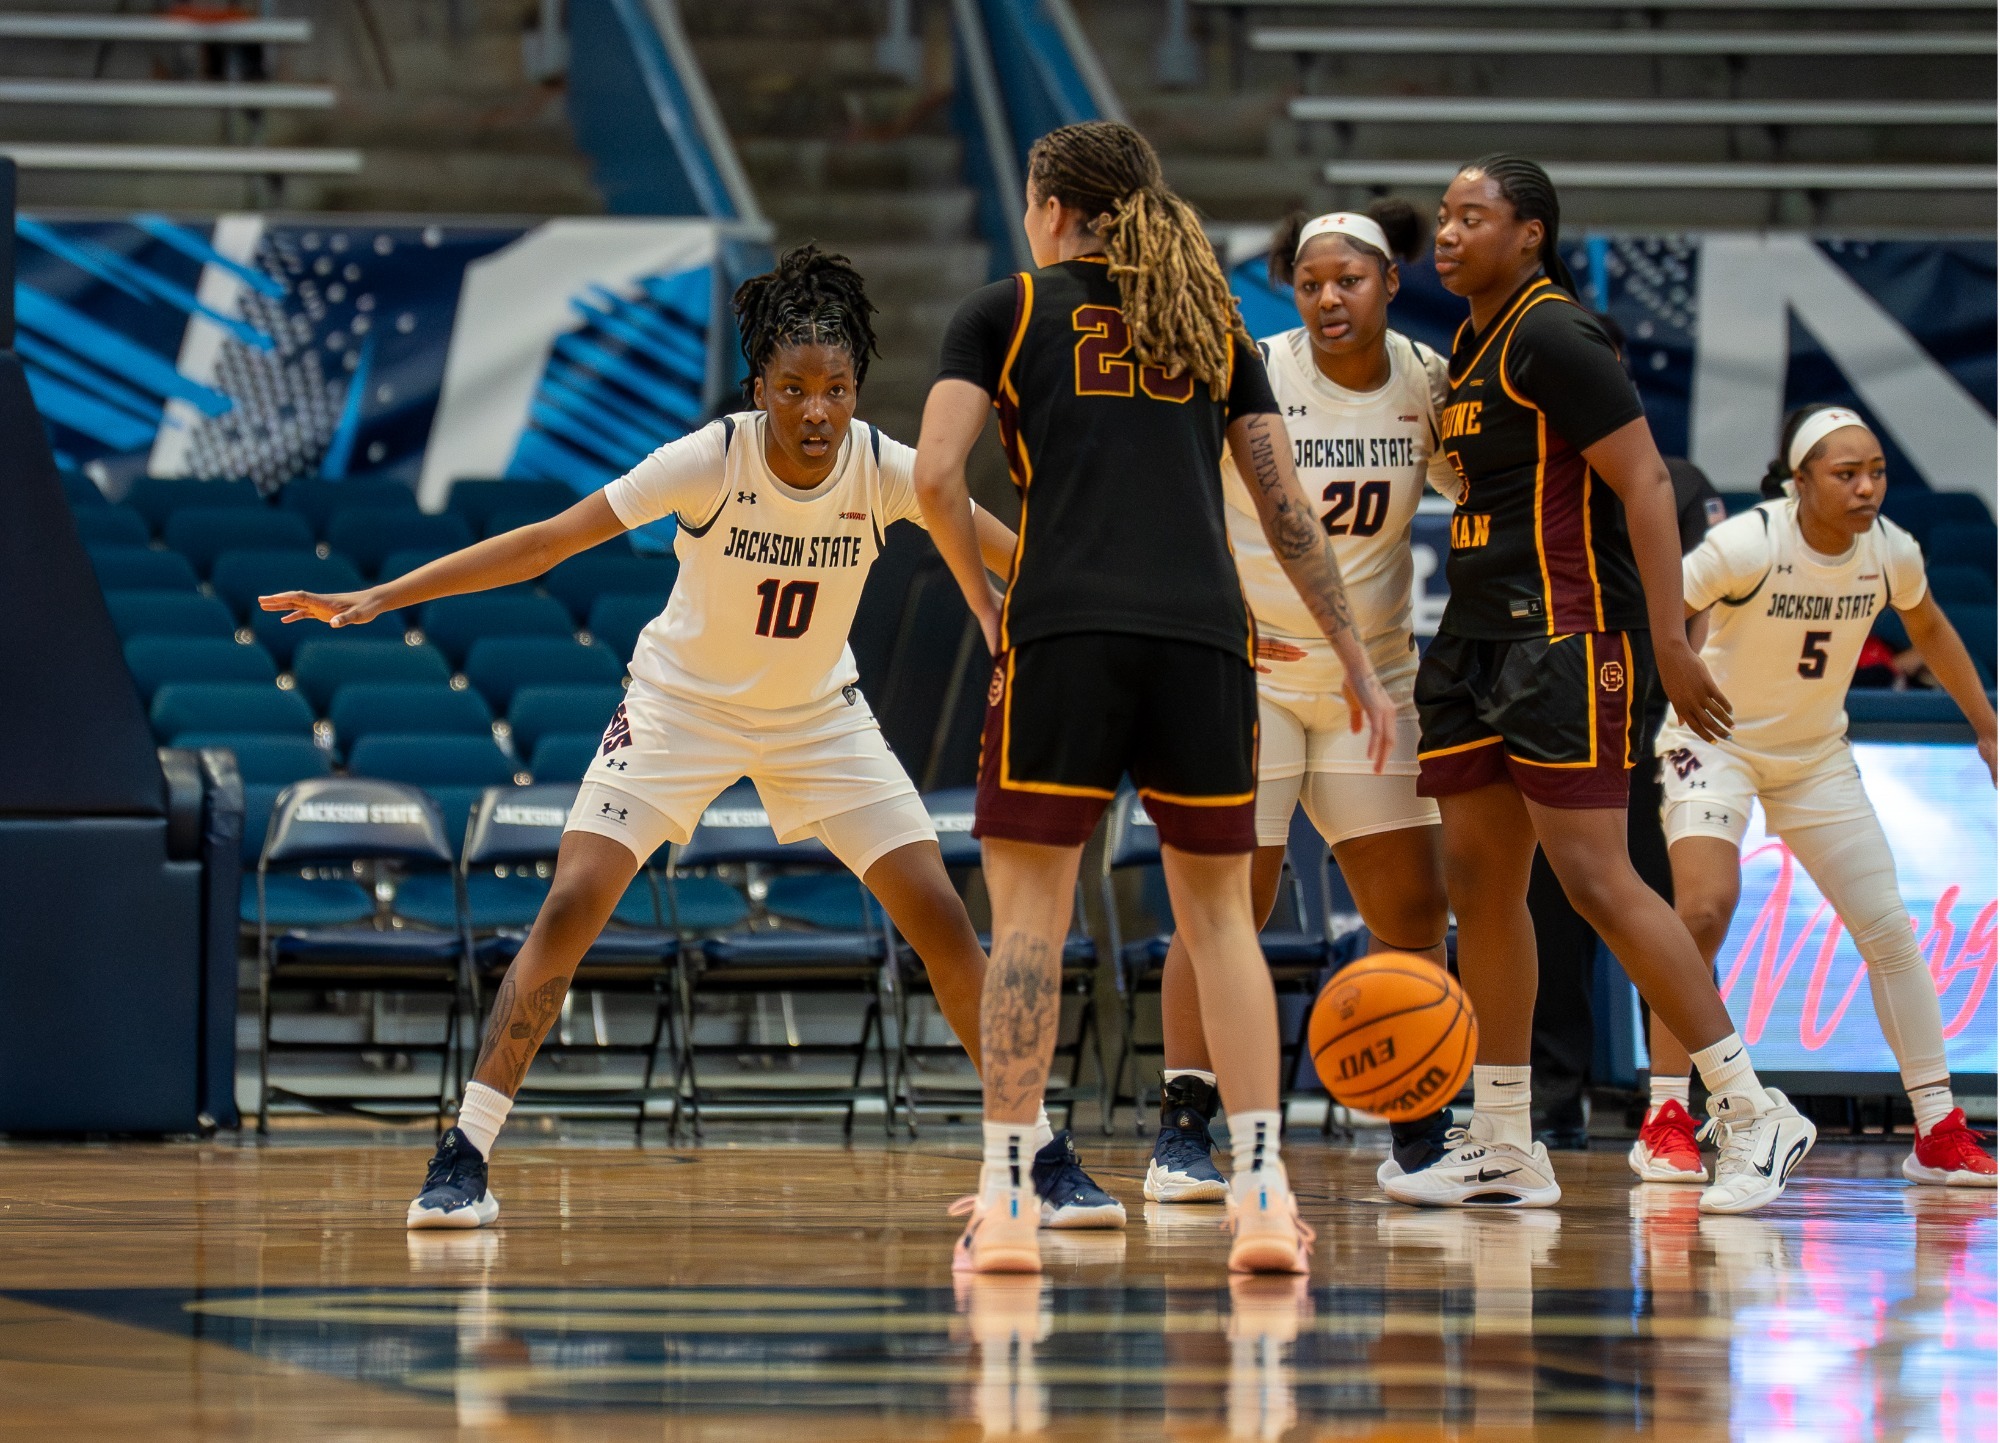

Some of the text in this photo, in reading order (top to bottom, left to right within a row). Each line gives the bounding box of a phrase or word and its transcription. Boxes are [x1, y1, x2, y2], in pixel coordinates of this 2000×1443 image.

[1294, 437, 1414, 468] JACKSON STATE
[1320, 480, 1391, 538] 20
[723, 526, 862, 568] JACKSON STATE
[755, 578, 820, 640] 10
[1767, 593, 1877, 621] JACKSON STATE
[1797, 630, 1833, 680] 5
